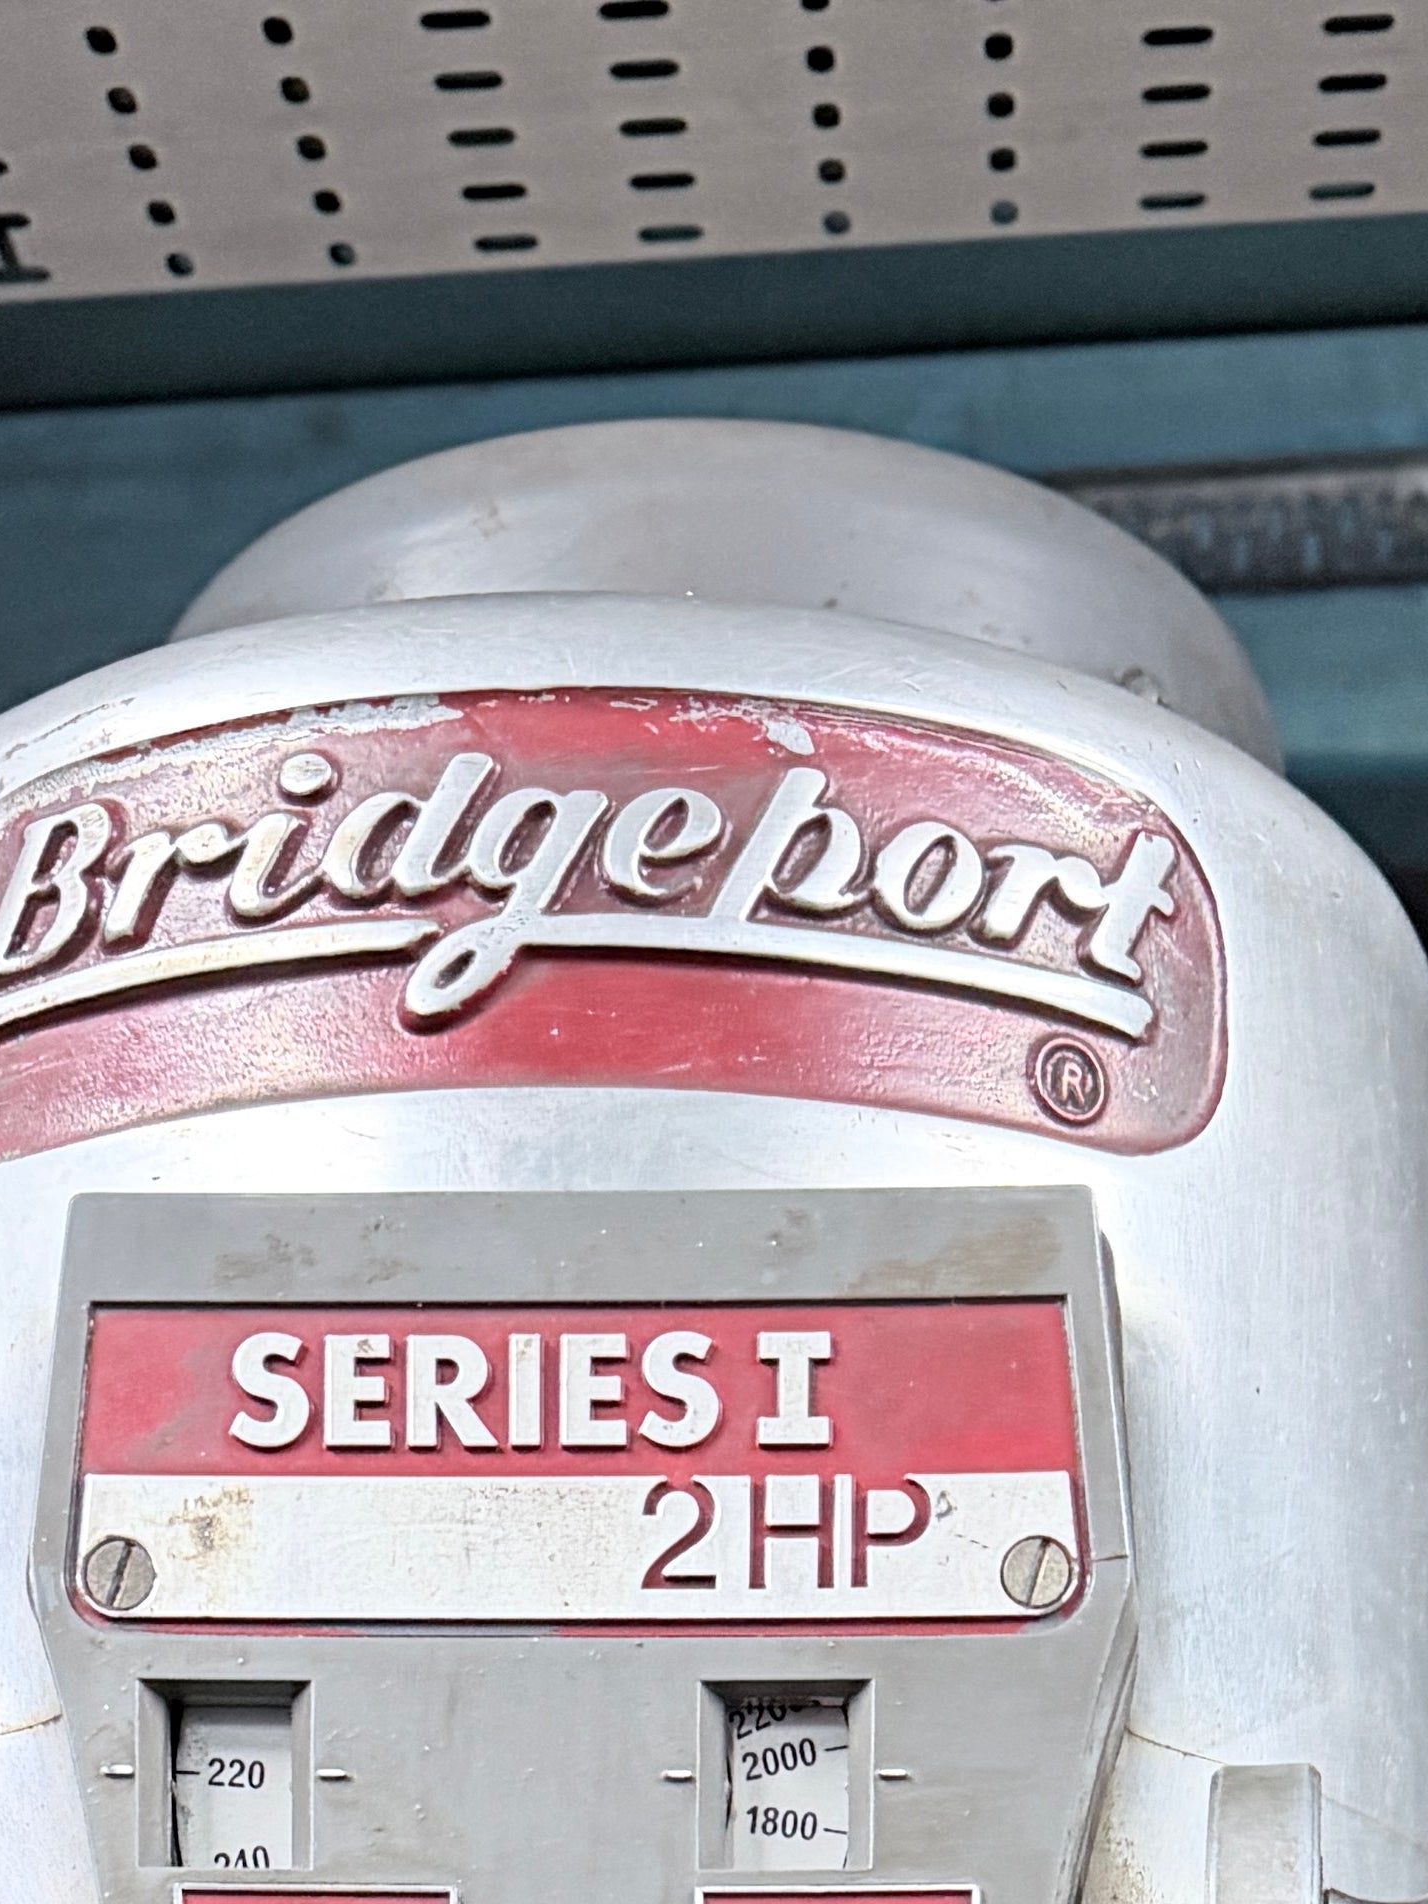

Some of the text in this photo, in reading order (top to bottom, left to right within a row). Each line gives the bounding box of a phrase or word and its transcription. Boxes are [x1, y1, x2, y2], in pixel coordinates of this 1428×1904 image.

[229, 1331, 834, 1449] SERIES I
[208, 1757, 266, 1789] 220
[741, 1737, 817, 1781] 2000
[746, 1805, 818, 1840] 1800
